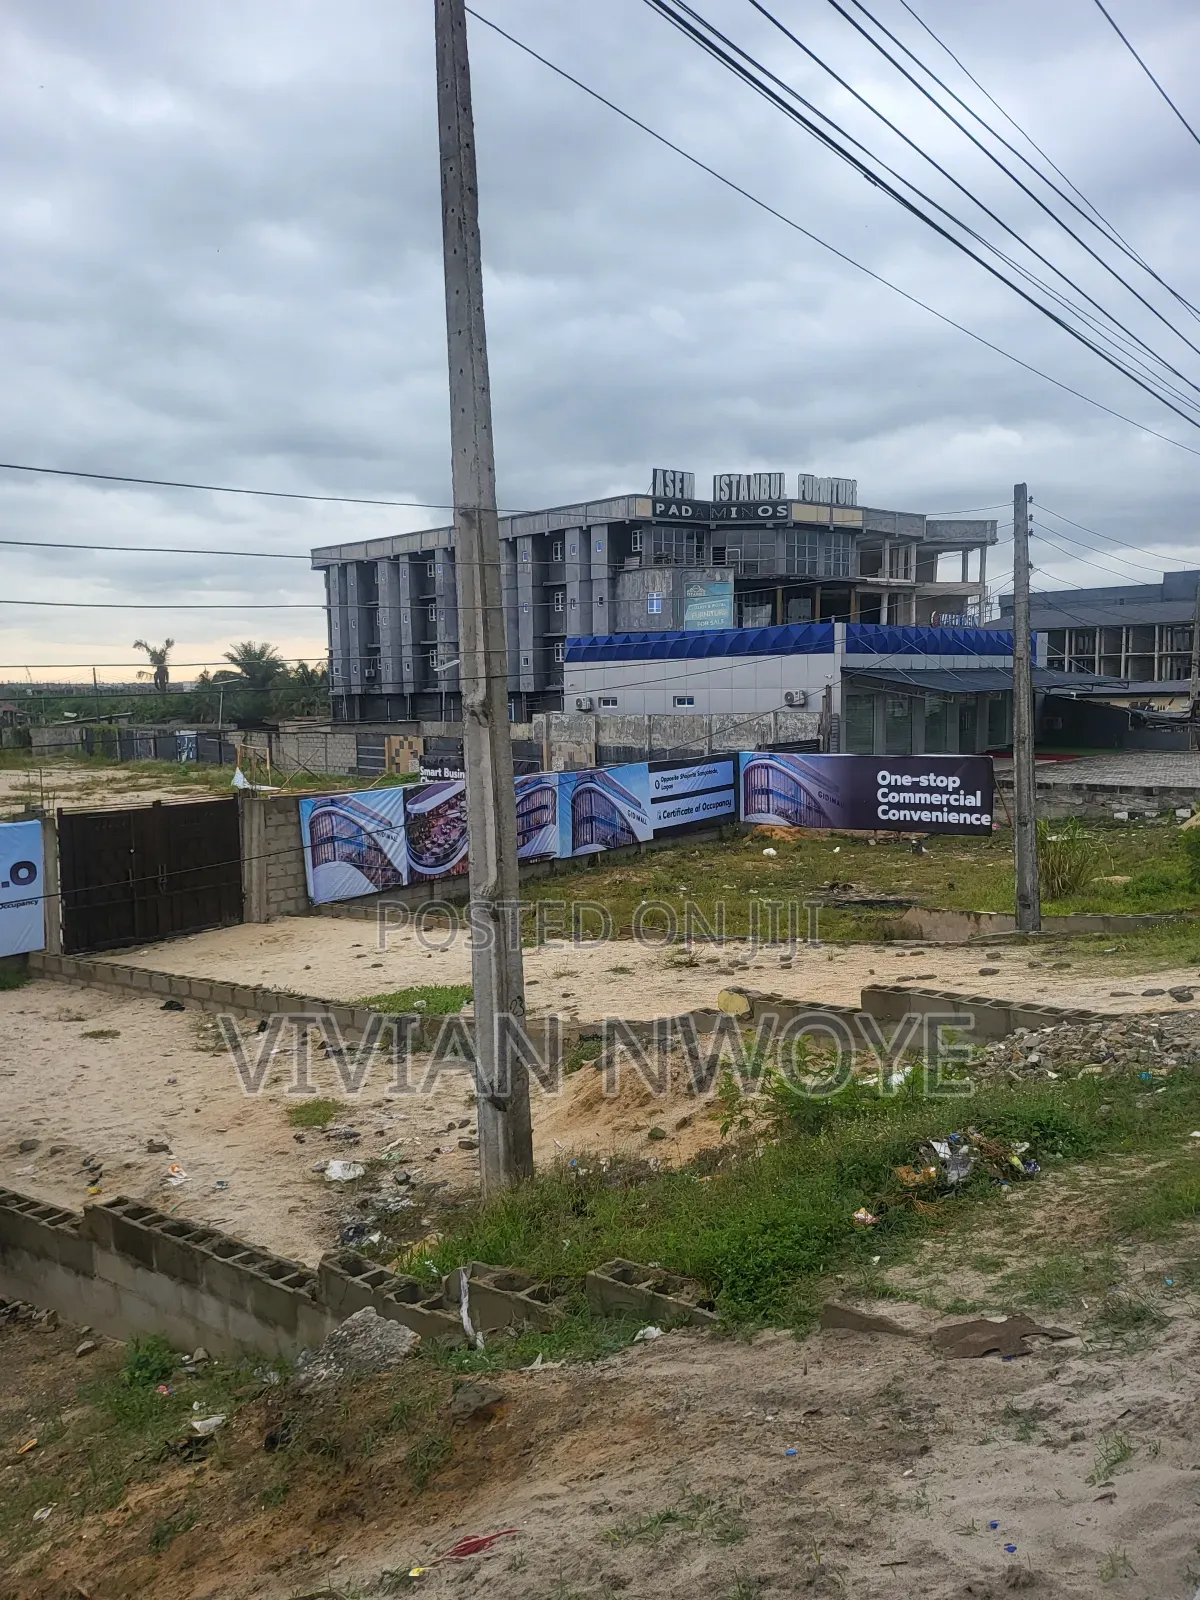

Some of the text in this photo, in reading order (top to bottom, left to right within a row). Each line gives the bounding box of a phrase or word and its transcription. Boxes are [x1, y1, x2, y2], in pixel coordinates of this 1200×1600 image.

[714, 473, 787, 501] ISTANBUL
[799, 474, 858, 506] FURNITURE
[420, 766, 465, 779] Smart Busin
[877, 770, 960, 791] One-stop
[877, 788, 981, 807] Commercial
[663, 799, 732, 819] Certificate of Occupancy
[877, 805, 991, 825] Convenience
